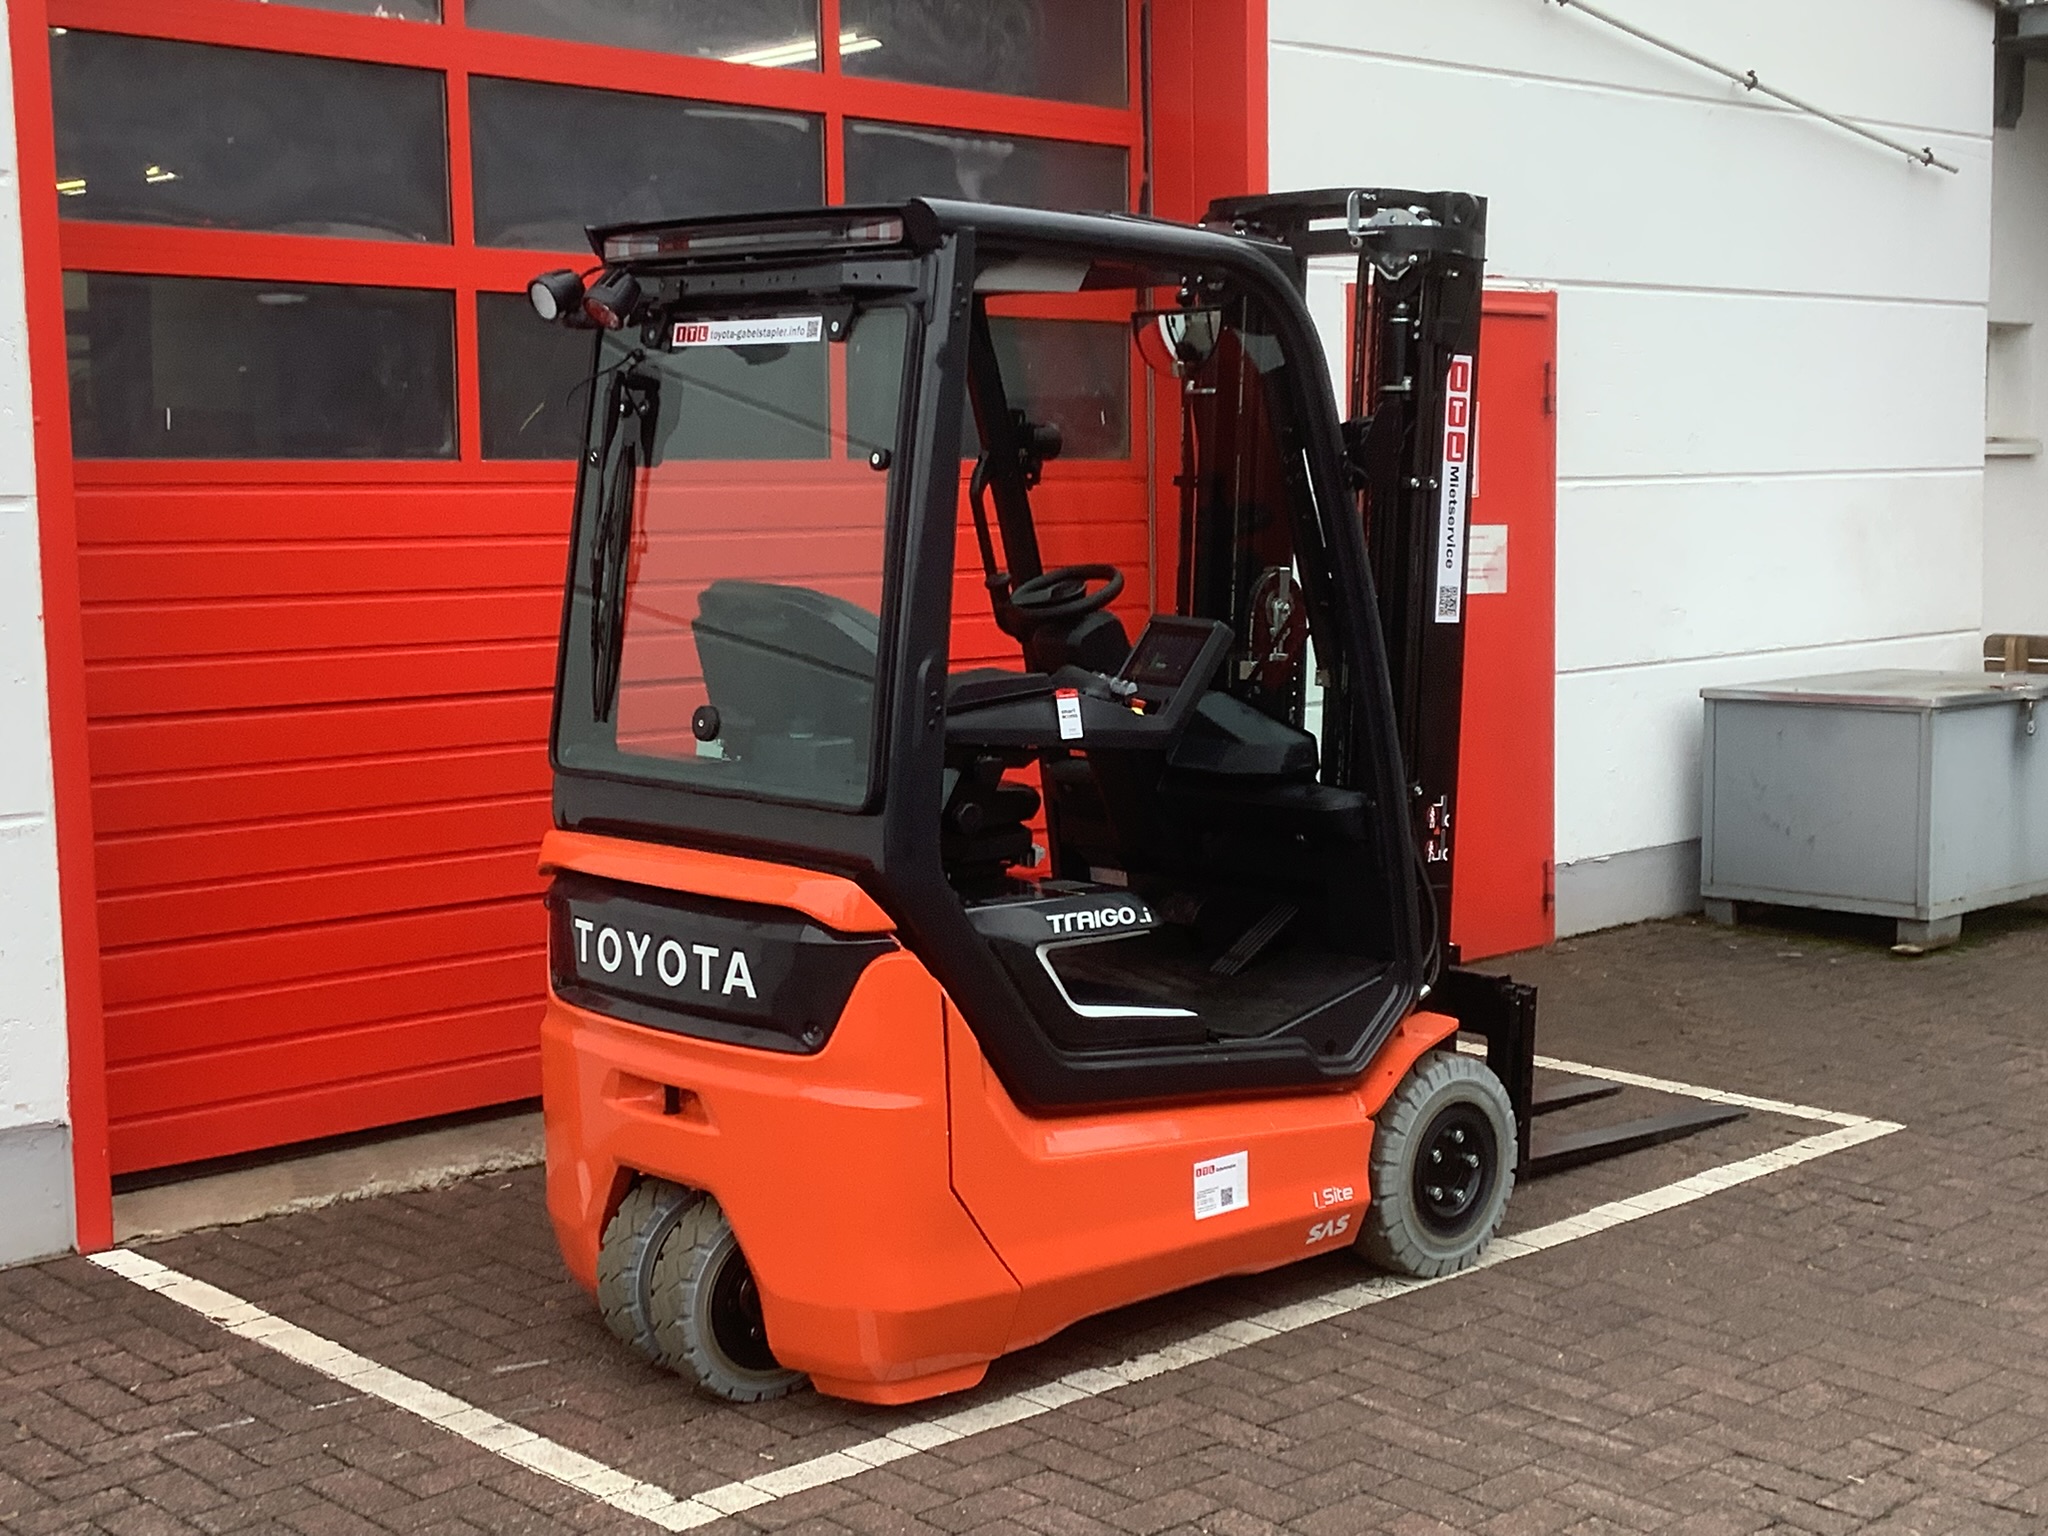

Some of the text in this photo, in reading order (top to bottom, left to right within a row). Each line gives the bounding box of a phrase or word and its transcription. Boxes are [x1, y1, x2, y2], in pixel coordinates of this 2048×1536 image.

[677, 326, 805, 342] ITL toyota-gabelstapler.info
[1445, 363, 1467, 569] ITL Mietservice
[575, 918, 757, 999] TOYOTA
[1306, 1214, 1351, 1245] SAS
